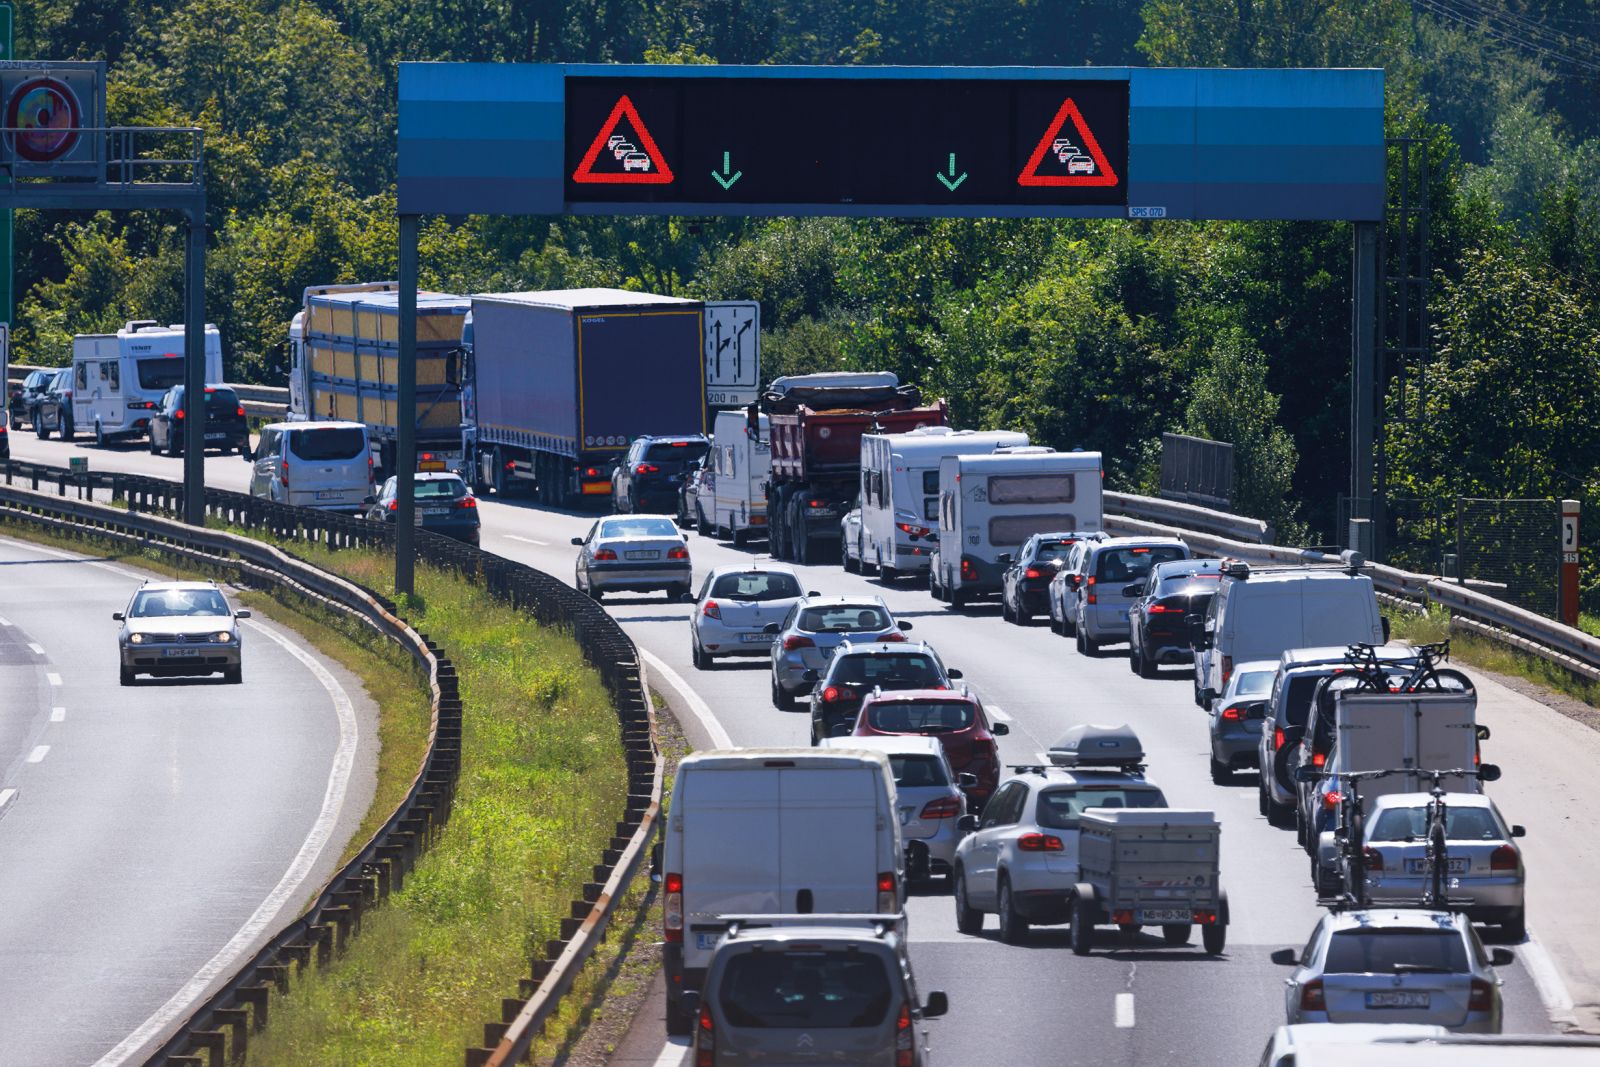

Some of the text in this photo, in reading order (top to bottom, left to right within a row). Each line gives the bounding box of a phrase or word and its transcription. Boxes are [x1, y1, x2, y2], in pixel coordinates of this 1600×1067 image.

[1131, 207, 1148, 217] SPIS
[708, 392, 738, 403] 200 m
